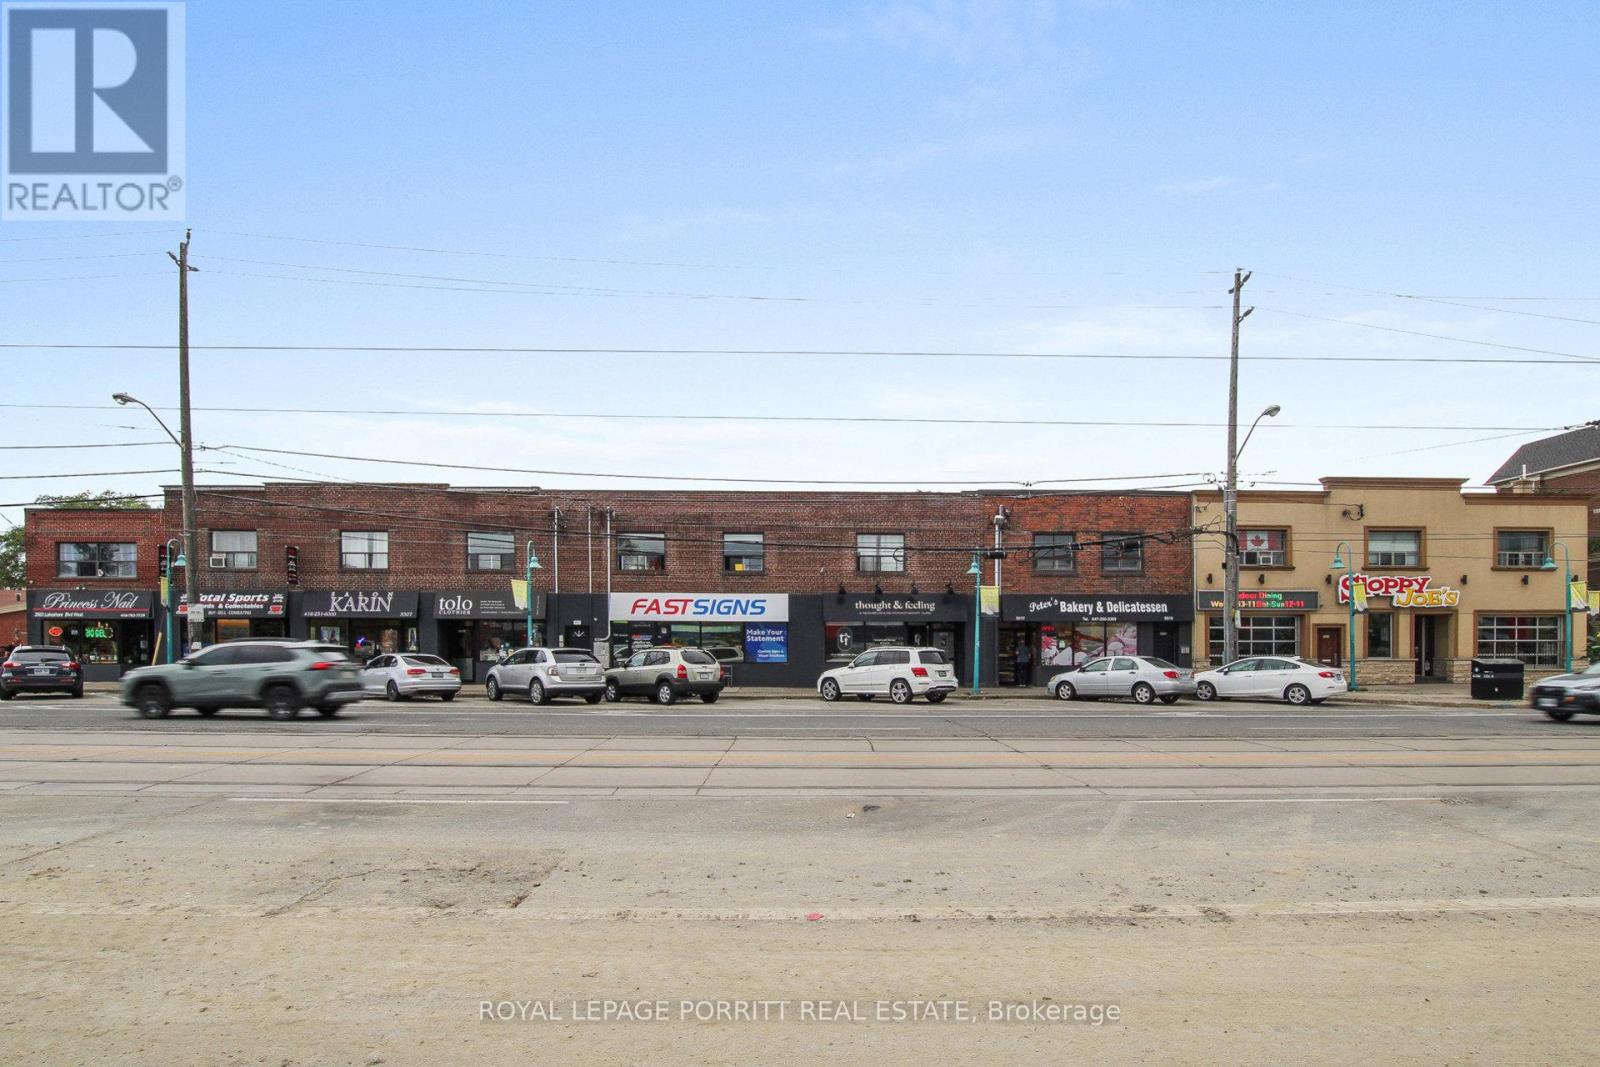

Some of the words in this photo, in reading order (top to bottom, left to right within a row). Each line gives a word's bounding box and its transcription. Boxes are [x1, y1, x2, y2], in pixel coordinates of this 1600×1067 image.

[42, 592, 99, 609] Princess
[100, 592, 139, 609] Nail
[199, 593, 227, 602] otal
[227, 593, 270, 603] Sports
[439, 595, 473, 610] tolo
[1259, 592, 1282, 600] Dining
[329, 596, 393, 613] KARIN
[631, 598, 767, 615] FASTSIGNS
[855, 600, 891, 611] thought
[893, 601, 903, 610] &
[905, 601, 936, 611] feeling
[1029, 597, 1059, 612] Peter's
[1060, 601, 1094, 615] Bakery
[1096, 601, 1104, 613] &
[1106, 601, 1168, 613] Delicatessen
